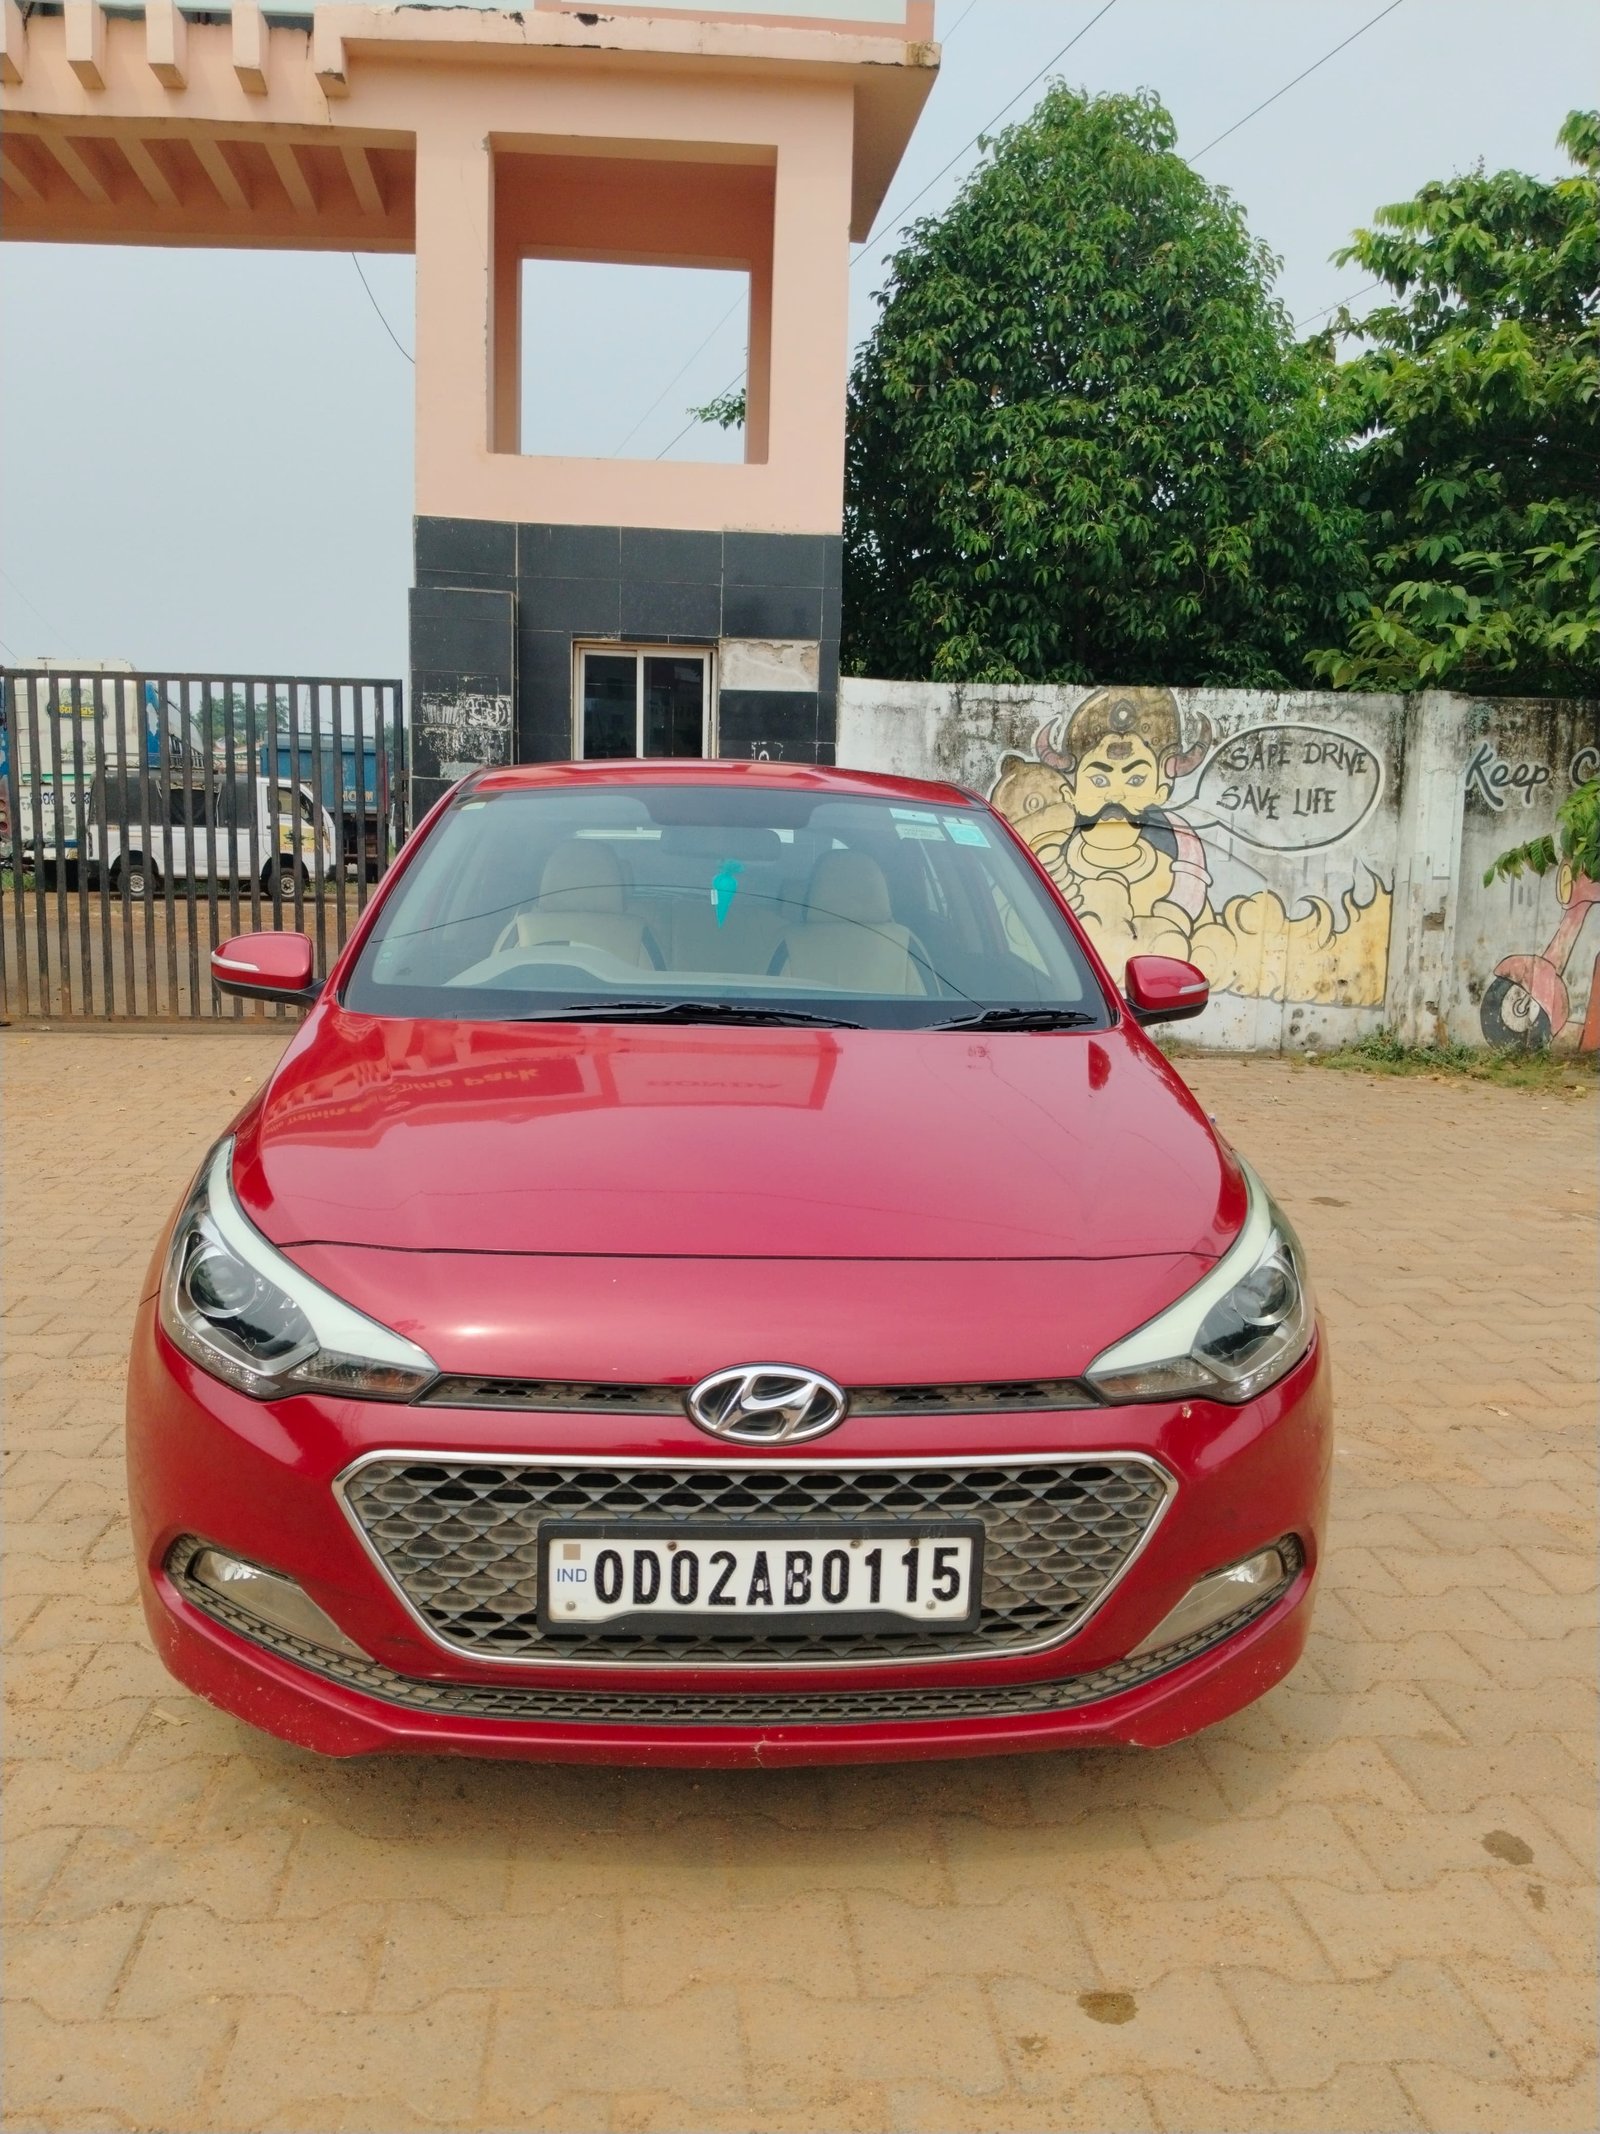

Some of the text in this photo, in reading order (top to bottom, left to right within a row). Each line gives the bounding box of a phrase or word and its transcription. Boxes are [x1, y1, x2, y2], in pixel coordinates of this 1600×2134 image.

[1303, 742, 1367, 777] DRIVE
[1465, 743, 1550, 807] Keep
[1216, 783, 1337, 820] SAVE LIFE
[556, 1568, 588, 1583] IND
